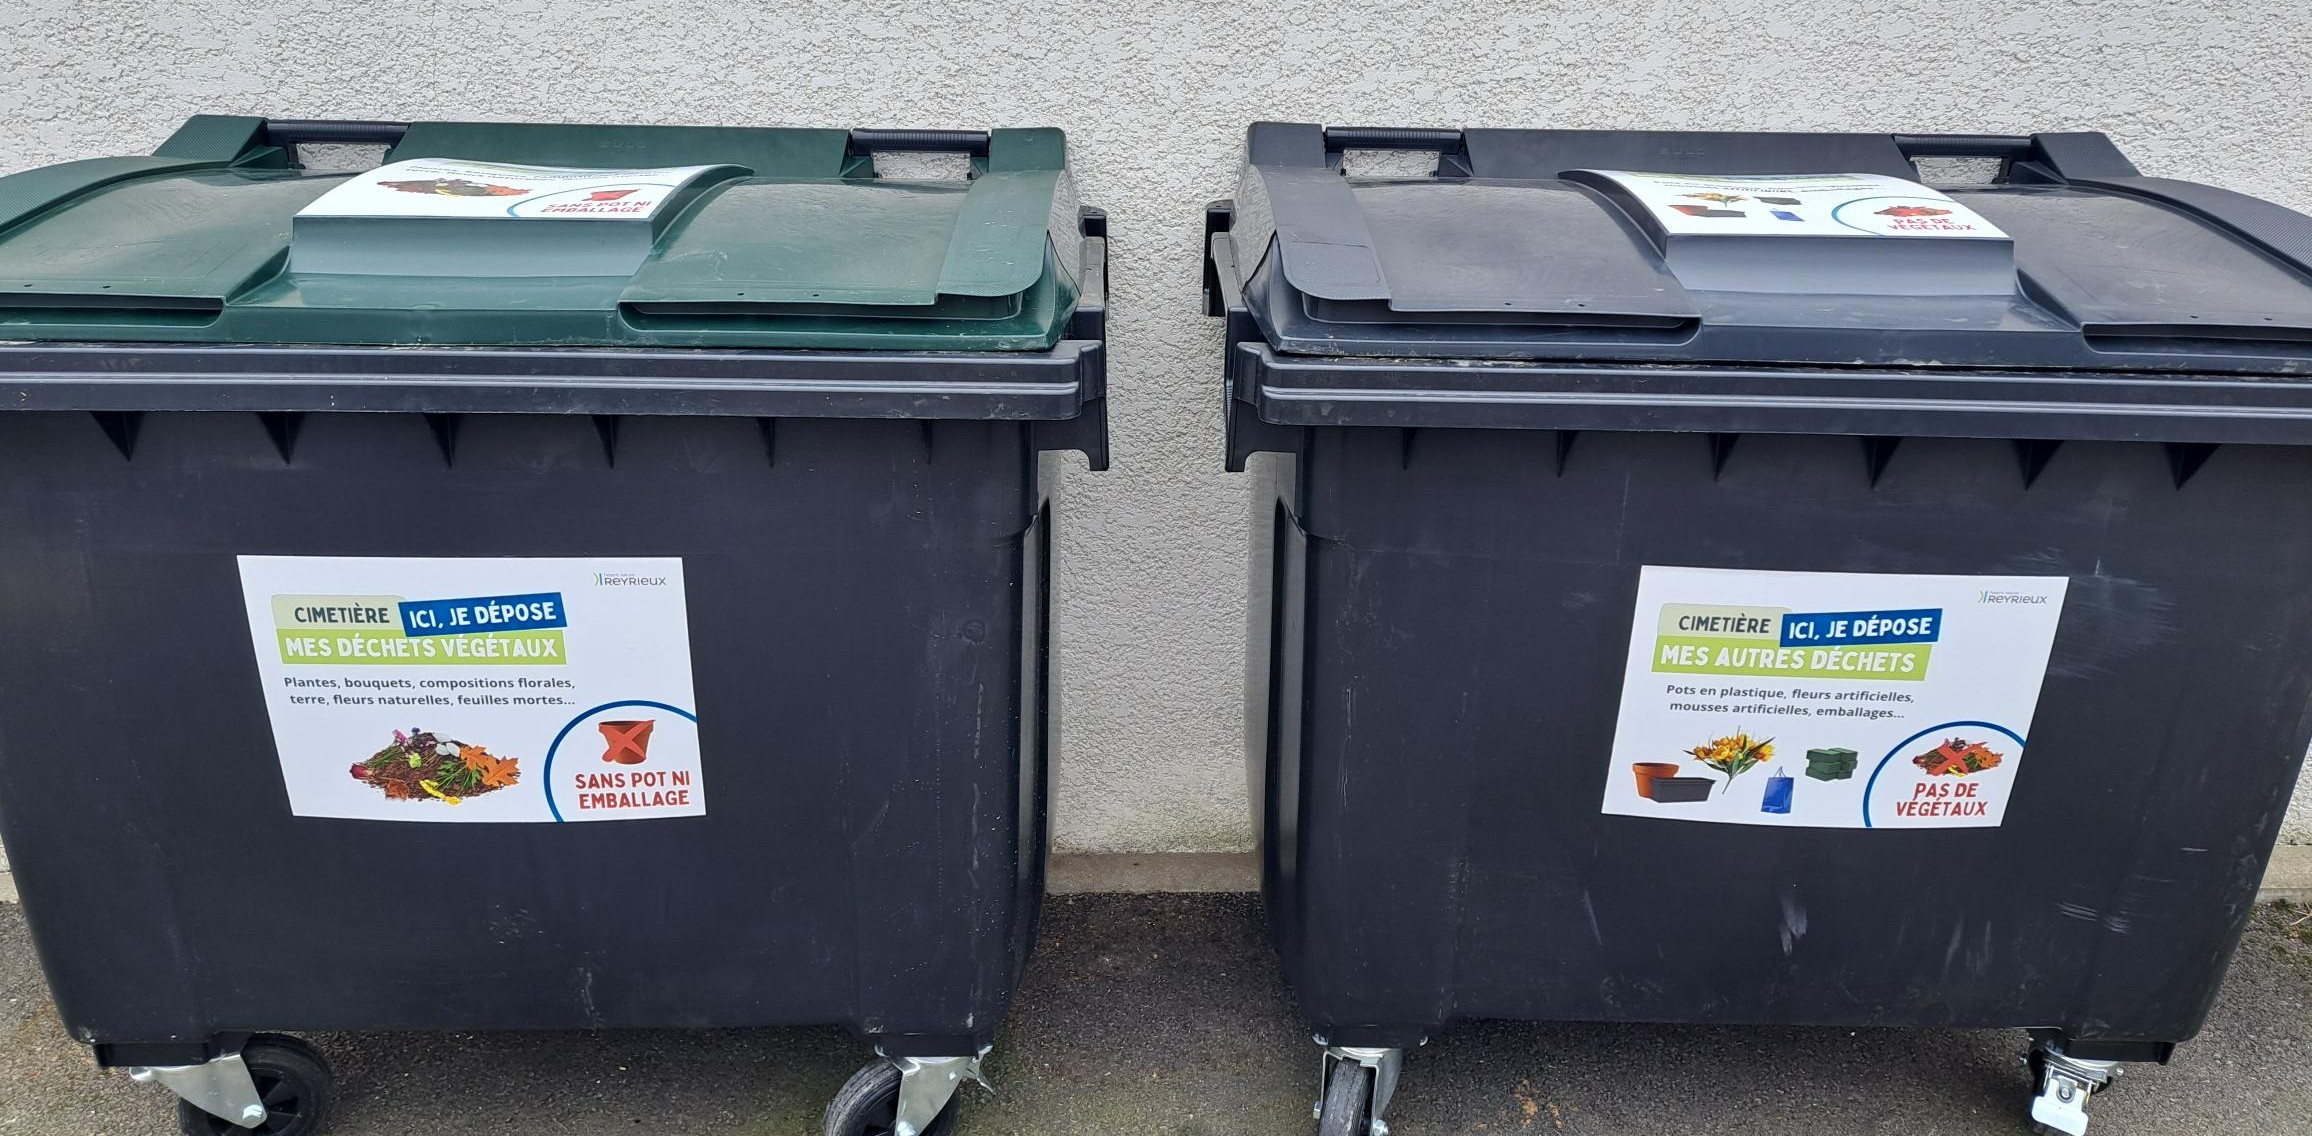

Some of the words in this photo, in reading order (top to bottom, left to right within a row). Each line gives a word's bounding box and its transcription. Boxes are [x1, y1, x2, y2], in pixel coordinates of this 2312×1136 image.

[294, 603, 390, 624] CIMETIÈRE
[409, 610, 444, 629] ICI,
[449, 607, 471, 626] JE
[474, 600, 558, 625] DÉPOSE
[1678, 613, 1772, 634] CIMETIÈRE
[1788, 621, 1820, 641] ICI,
[1825, 620, 1848, 638] JE
[1852, 615, 1933, 637] DÉPOSE
[285, 637, 332, 657] MES
[337, 633, 436, 658] DÉCHETS
[440, 633, 559, 658] VÉGÉTAUX
[1660, 644, 1710, 667] MES
[1715, 647, 1805, 670] AUTRES
[1810, 645, 1917, 673] DÉCHETS
[284, 677, 341, 690] Plantes,
[345, 677, 416, 692] bouquets,
[419, 678, 515, 693] compositions
[518, 677, 576, 690] florales,
[1666, 684, 1696, 695] Pots
[1699, 687, 1717, 696] en
[1720, 686, 1787, 700] plastique,
[1791, 688, 1831, 700] fleurs
[1835, 690, 1915, 704] artificielles,
[290, 694, 330, 706] terre,
[333, 694, 374, 706] fleurs
[378, 695, 454, 706] naturelles,
[457, 694, 510, 706] feuilles
[513, 695, 576, 706] mortes...
[1669, 702, 1729, 713] mousses
[1732, 702, 1813, 717] artificielles,
[1816, 706, 1905, 721] emballages...
[575, 772, 626, 789] SANS
[631, 771, 666, 788] POT
[672, 770, 690, 786] NI
[579, 790, 689, 809] EMBALLAGE
[1914, 783, 1950, 799] PAS
[1954, 783, 1979, 798] DE
[1896, 797, 1988, 816] VÉGÉTAUX
